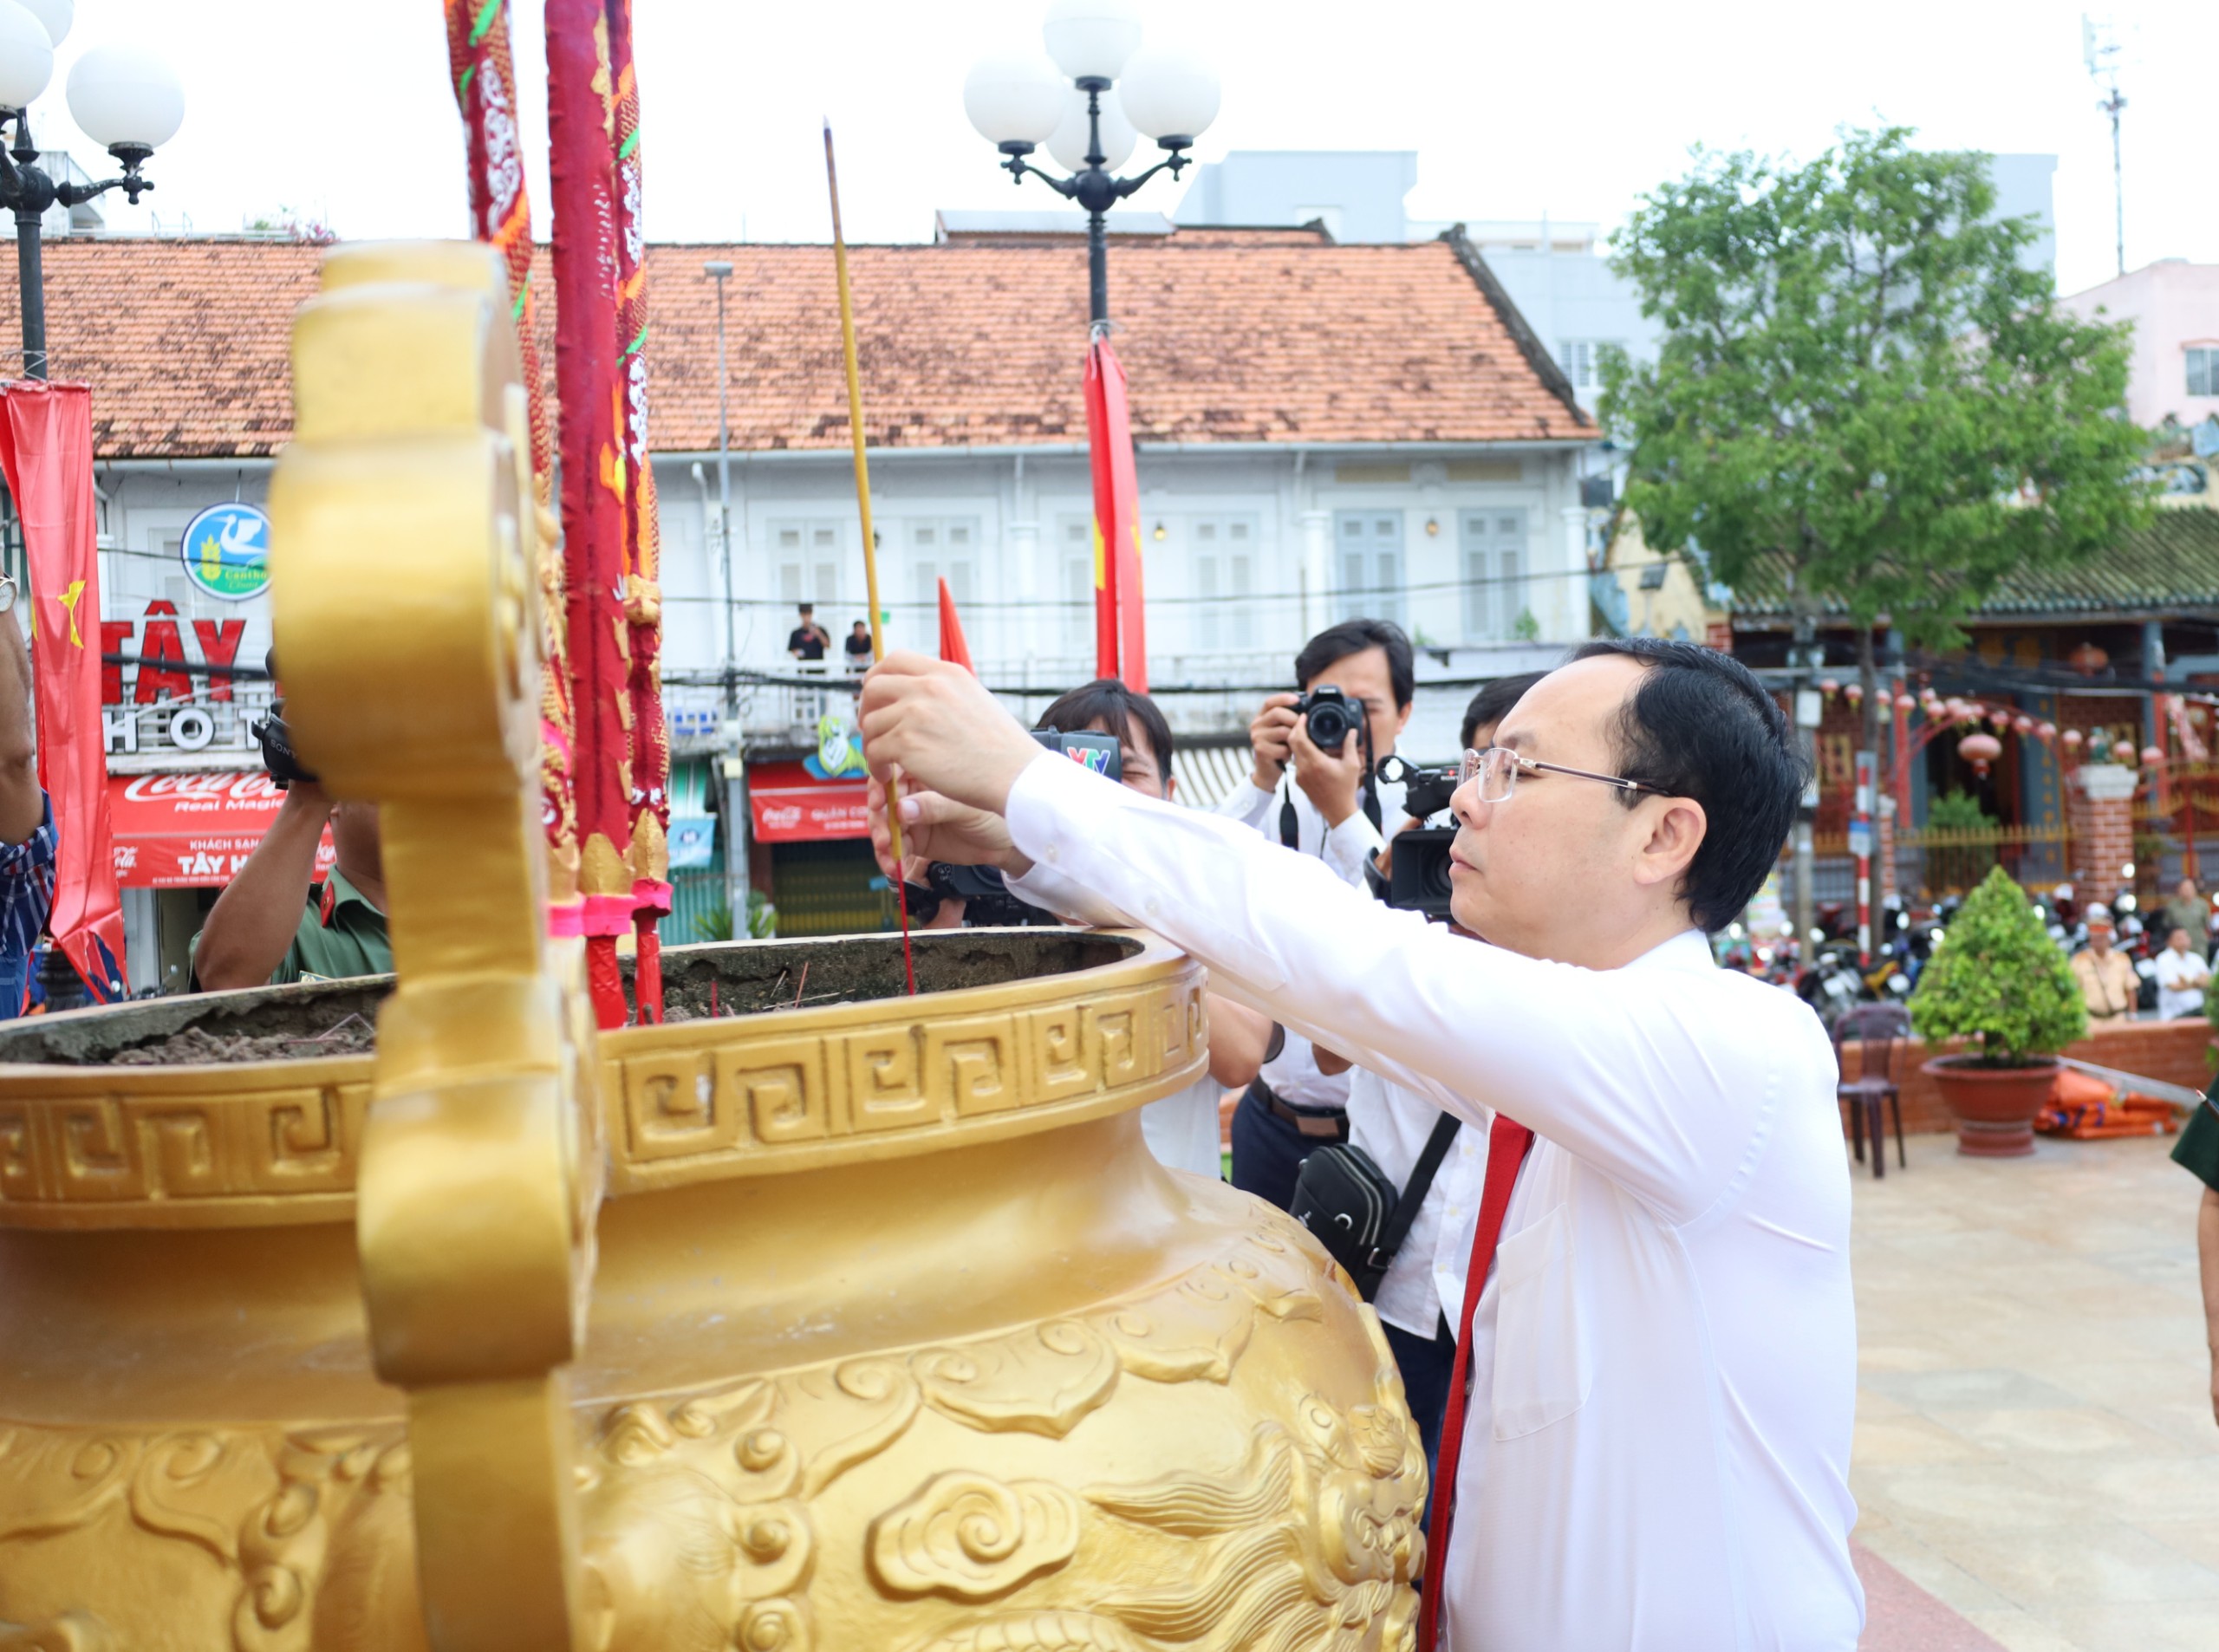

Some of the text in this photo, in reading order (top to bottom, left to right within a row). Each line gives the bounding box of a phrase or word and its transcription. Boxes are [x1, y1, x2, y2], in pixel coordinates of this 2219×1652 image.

[101, 600, 247, 705] TÂY
[102, 706, 271, 753] HOT
[1067, 746, 1111, 777] VTV
[174, 800, 220, 813] Real
[190, 837, 231, 851] KHÁCH
[177, 849, 249, 875] TÂY H
